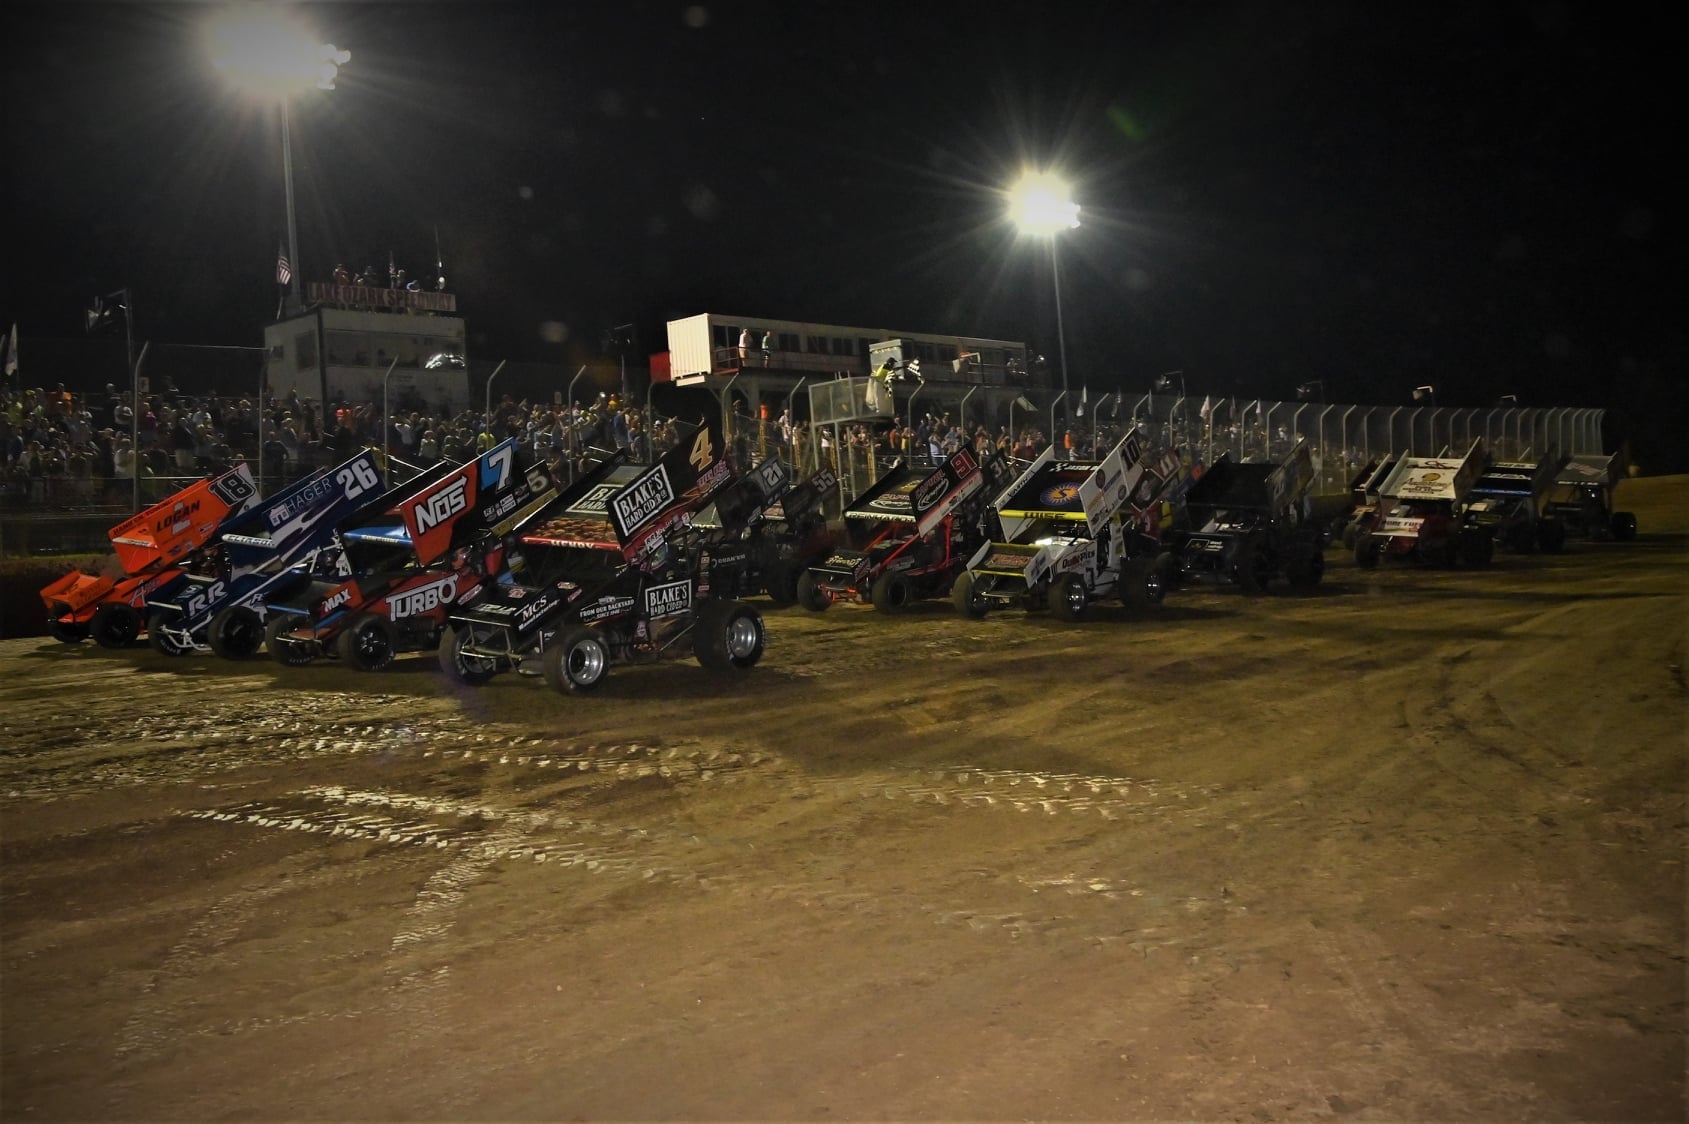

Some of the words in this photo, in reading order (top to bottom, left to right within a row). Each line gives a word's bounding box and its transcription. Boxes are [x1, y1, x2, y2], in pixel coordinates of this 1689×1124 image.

[689, 426, 713, 472] 4
[1122, 438, 1141, 470] 10
[336, 458, 378, 500] 26
[488, 444, 513, 493] 7
[762, 462, 784, 487] 21
[208, 469, 257, 507] 18
[287, 477, 332, 515] HAGER
[619, 472, 664, 518] BLAKE'S
[156, 501, 201, 532] LOGAN
[414, 474, 468, 536] NOS
[625, 508, 645, 529] HARD
[1023, 511, 1065, 520] WISE
[188, 581, 228, 617] RR
[321, 588, 352, 613] MAX
[385, 572, 459, 623] TURBO
[522, 595, 547, 622] MCS
[649, 584, 688, 606] BLAKE'S
[650, 603, 666, 616] HARD
[580, 608, 596, 619] FROM
